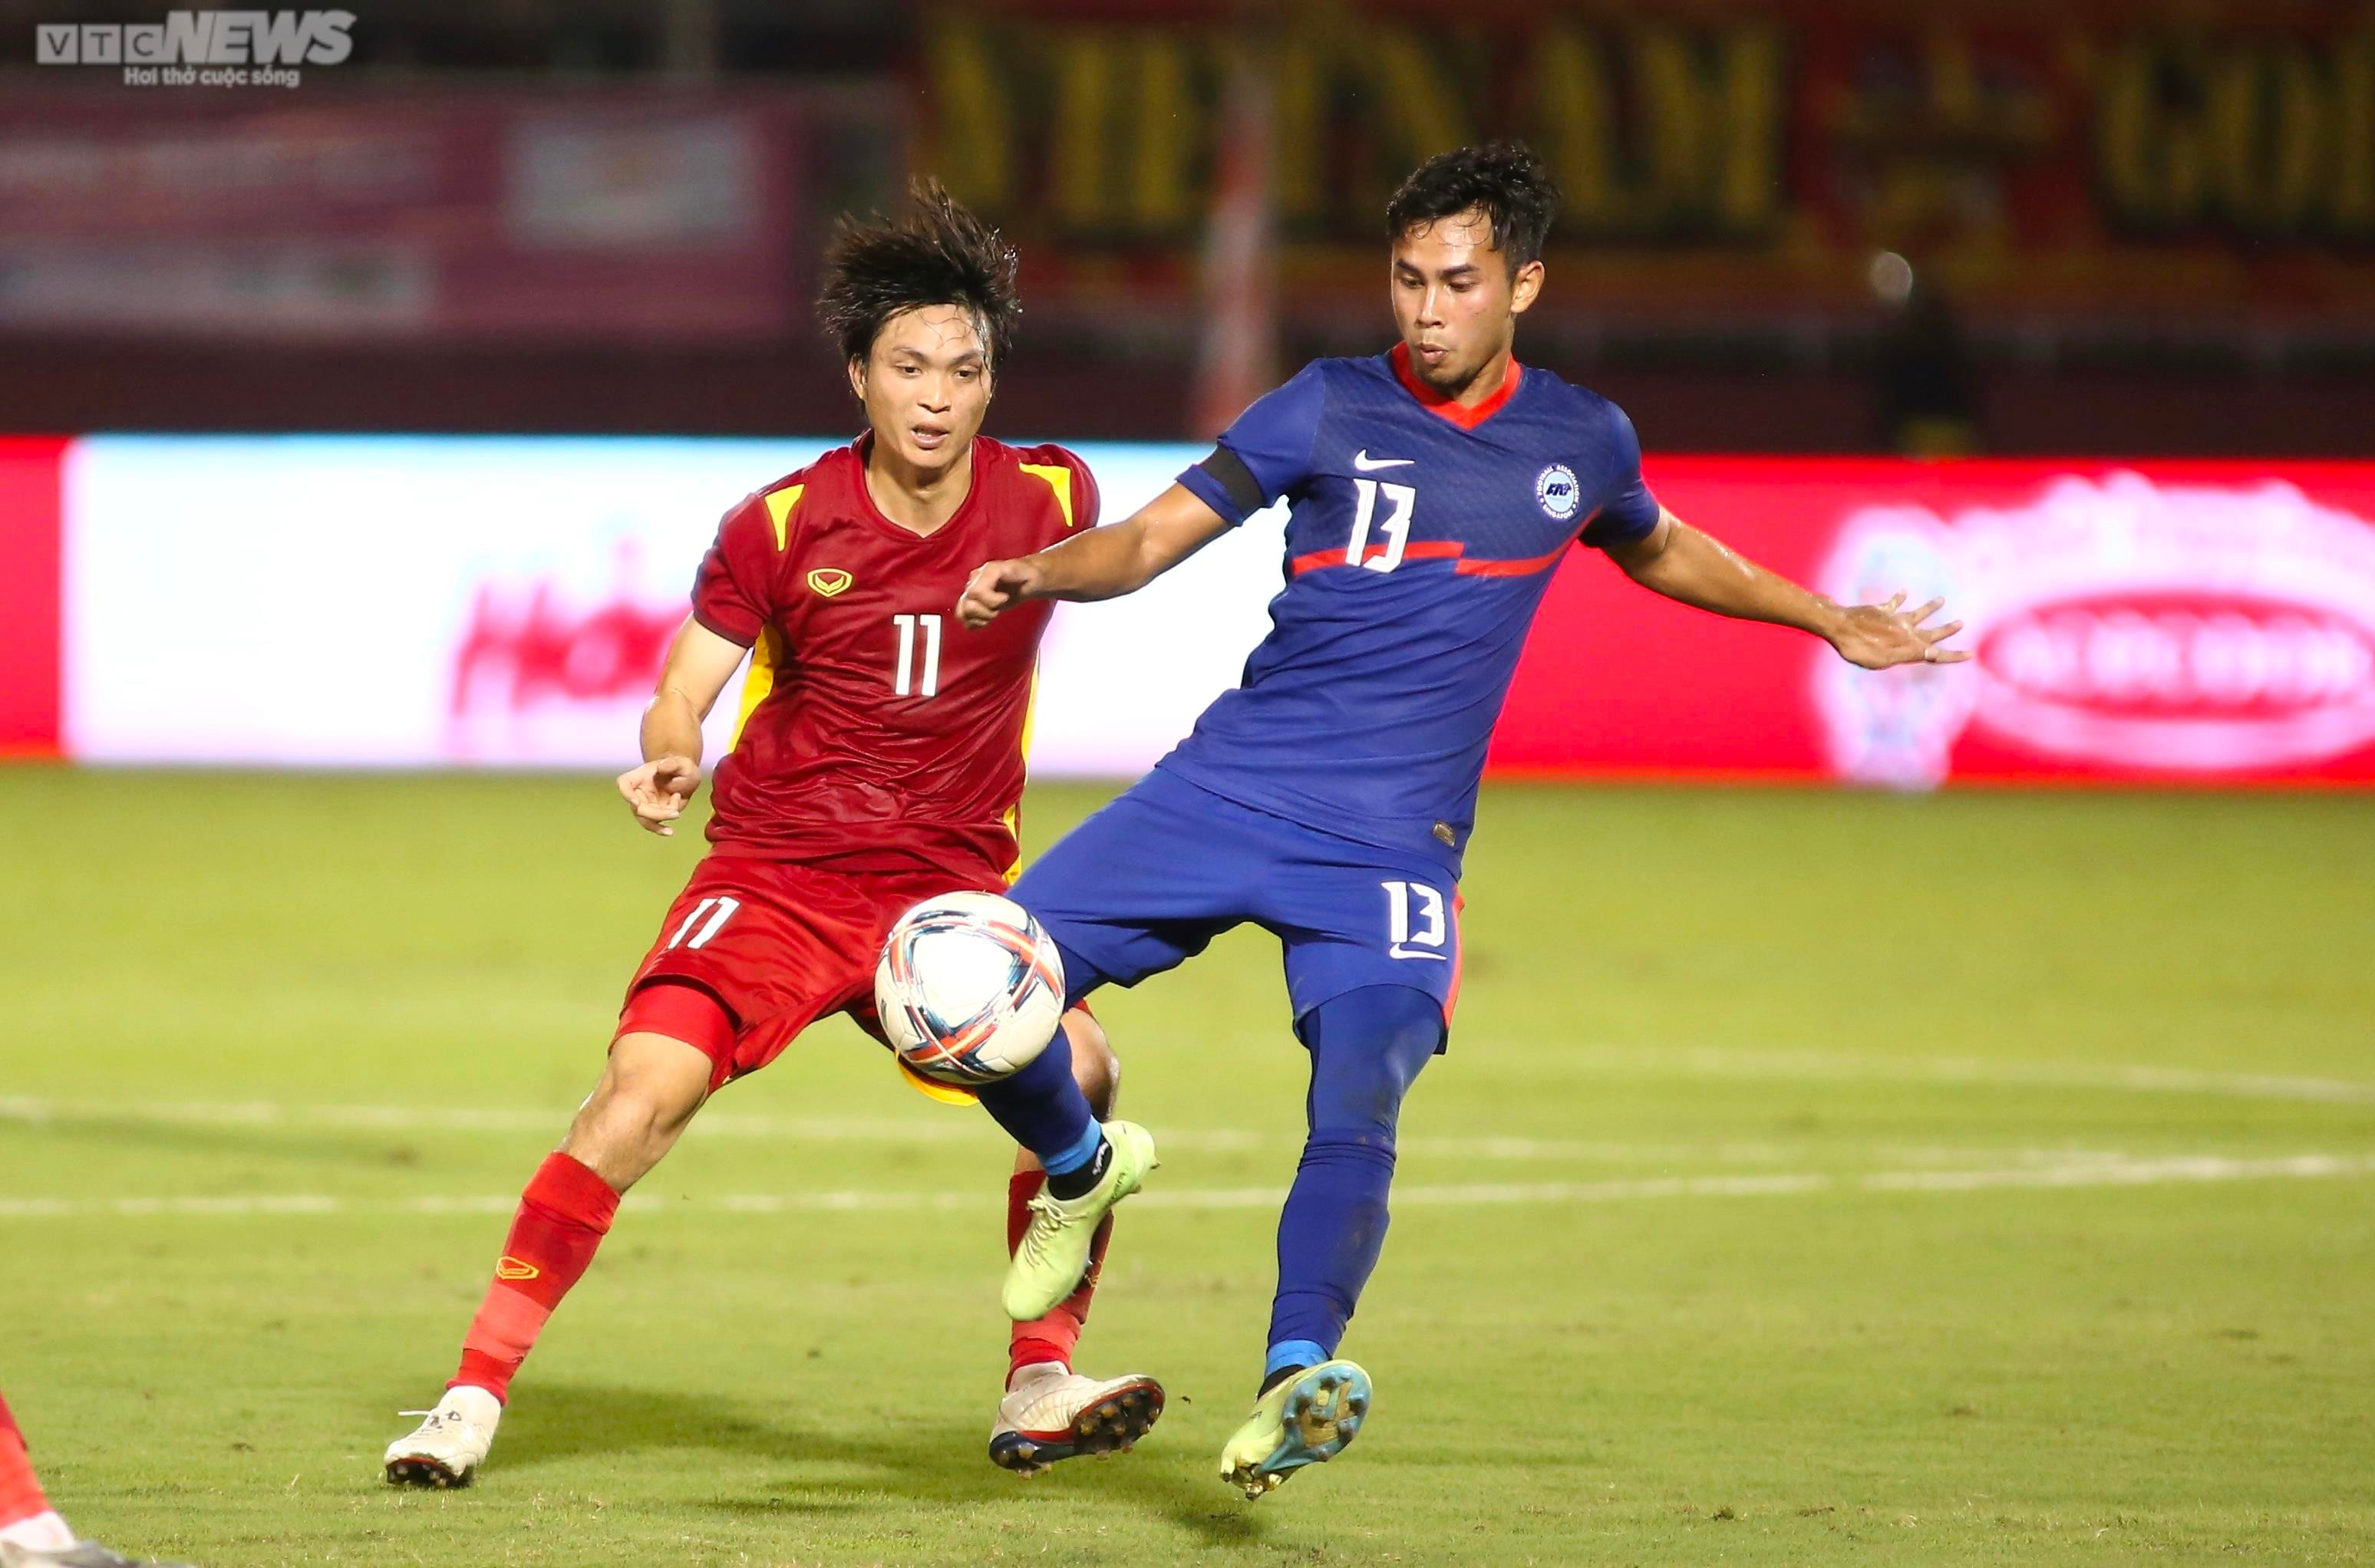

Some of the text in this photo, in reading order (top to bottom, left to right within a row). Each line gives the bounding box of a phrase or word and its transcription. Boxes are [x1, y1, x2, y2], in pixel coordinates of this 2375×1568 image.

[1536, 464, 1579, 502] FOOTBALL ASSOCIATION
[1542, 504, 1574, 519] SINGAPORE
[1345, 478, 1416, 573] 13
[893, 614, 942, 697] 11
[667, 896, 741, 950] 11
[1380, 881, 1446, 947] 13
